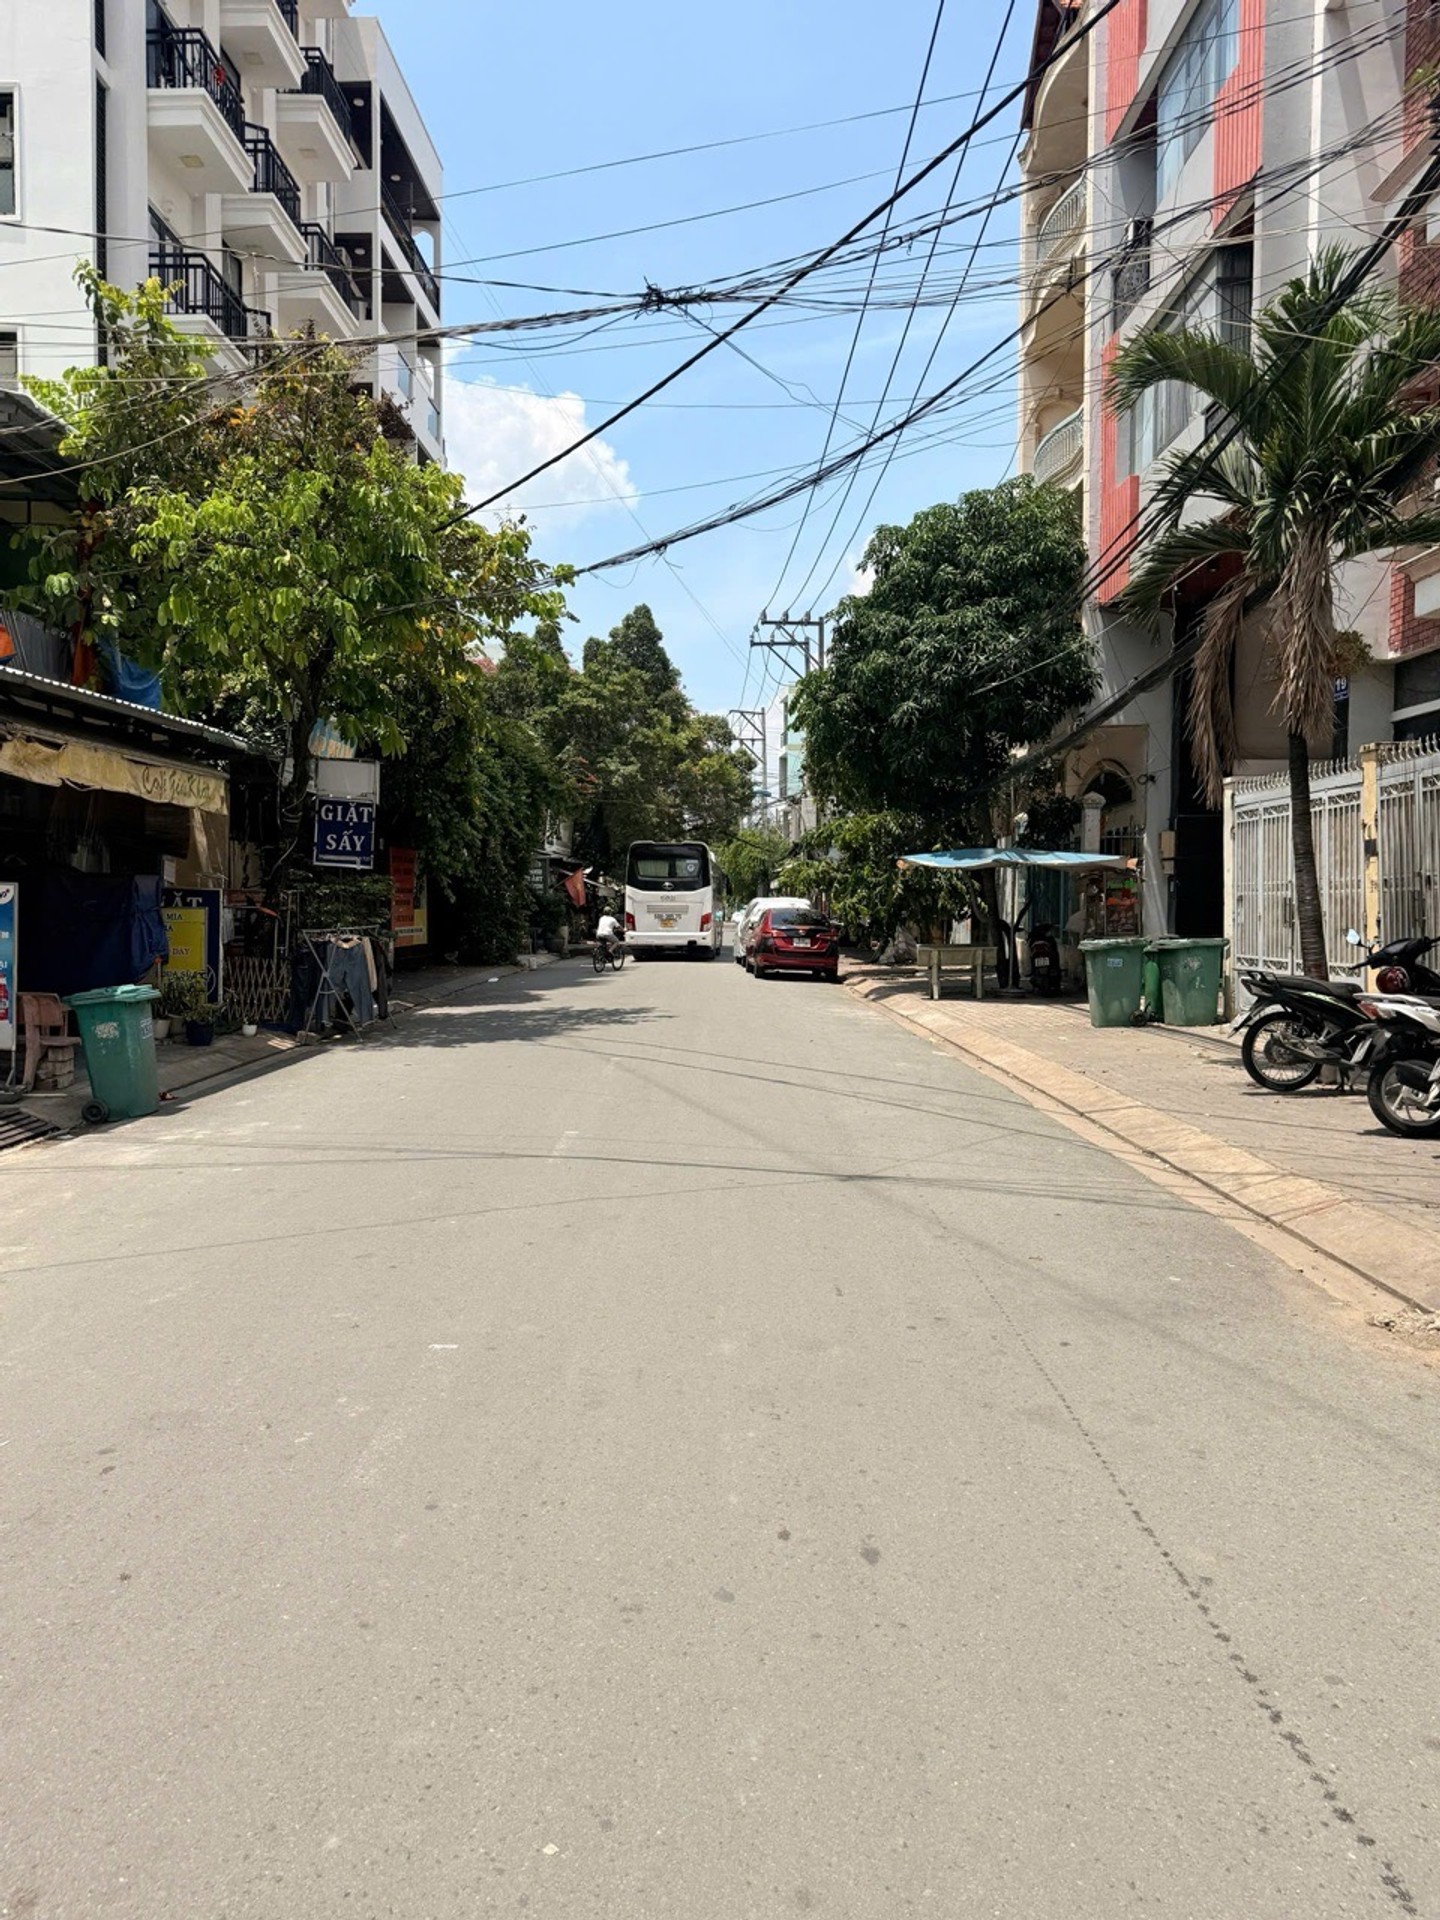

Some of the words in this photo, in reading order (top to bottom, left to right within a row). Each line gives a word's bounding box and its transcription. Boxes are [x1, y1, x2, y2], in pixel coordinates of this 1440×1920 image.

[1335, 677, 1347, 692] 19
[320, 802, 372, 827] GIẶT
[326, 830, 366, 851] SẤY
